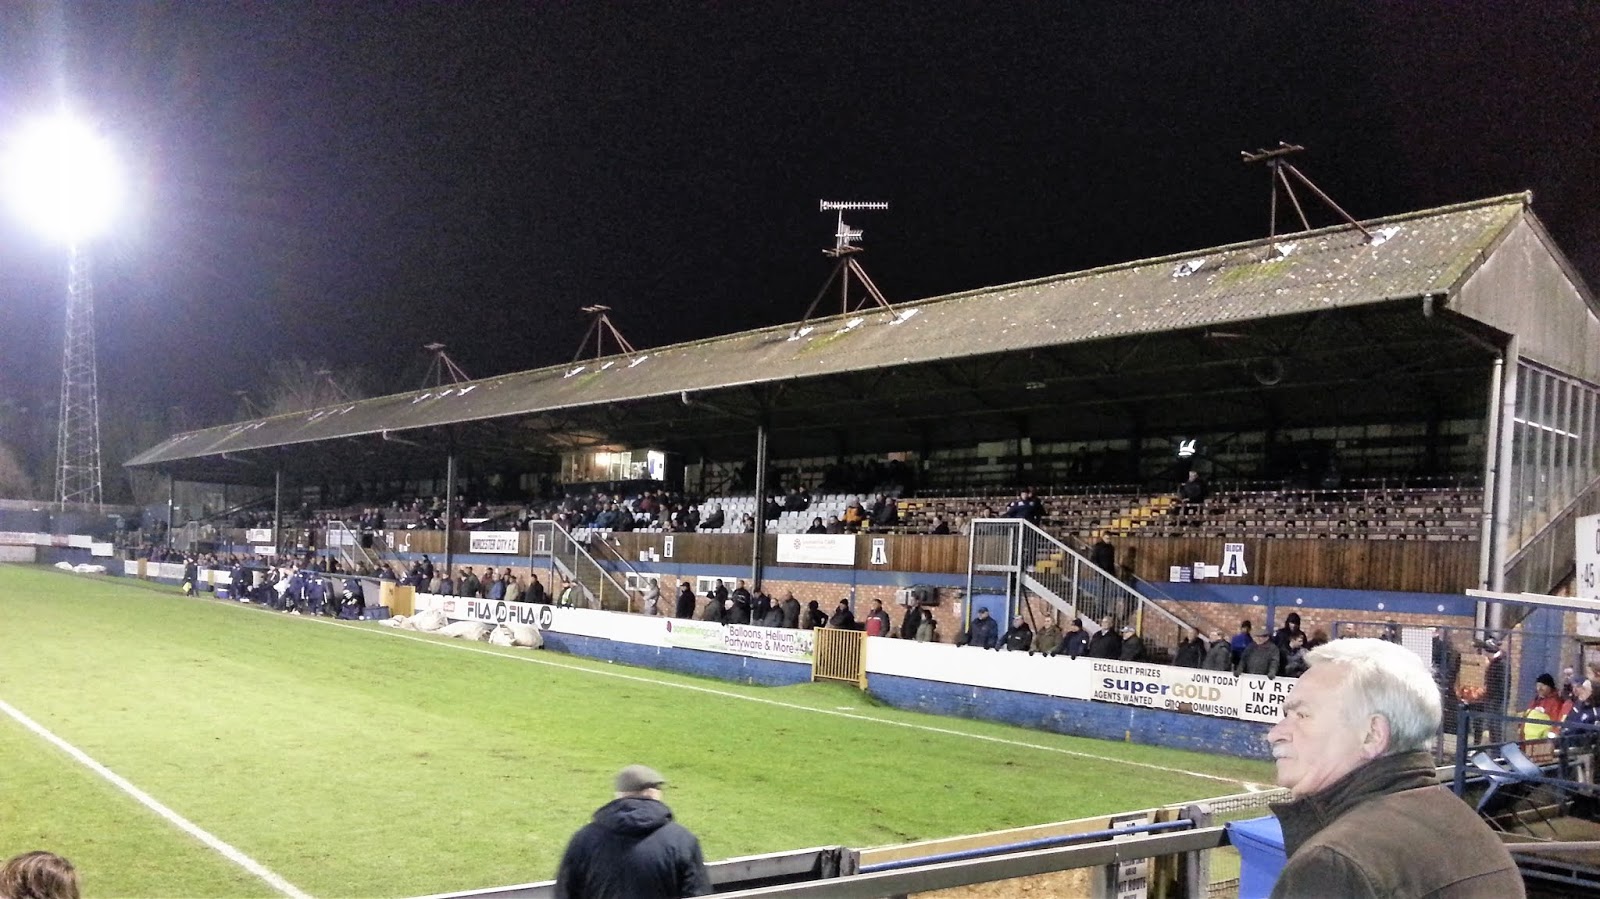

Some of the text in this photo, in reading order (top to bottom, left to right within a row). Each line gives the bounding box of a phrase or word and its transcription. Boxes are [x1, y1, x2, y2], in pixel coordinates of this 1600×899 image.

[472, 538, 496, 550] WORCESTER
[496, 539, 508, 550] CITY
[1226, 544, 1243, 552] BLOCK
[875, 547, 881, 563] A
[1228, 554, 1238, 575] A
[467, 601, 491, 620] FILA
[509, 605, 535, 625] FILA
[724, 636, 762, 650] Partyware
[765, 640, 771, 651] &
[1093, 663, 1161, 678] EXCELLENT PRIZES
[1191, 674, 1239, 687] JOIN TODAY
[1094, 690, 1153, 705] AGENTS WANTED
[1252, 692, 1265, 703] IN
[1189, 702, 1239, 716] OMMISSION
[1245, 703, 1278, 717] EACH
